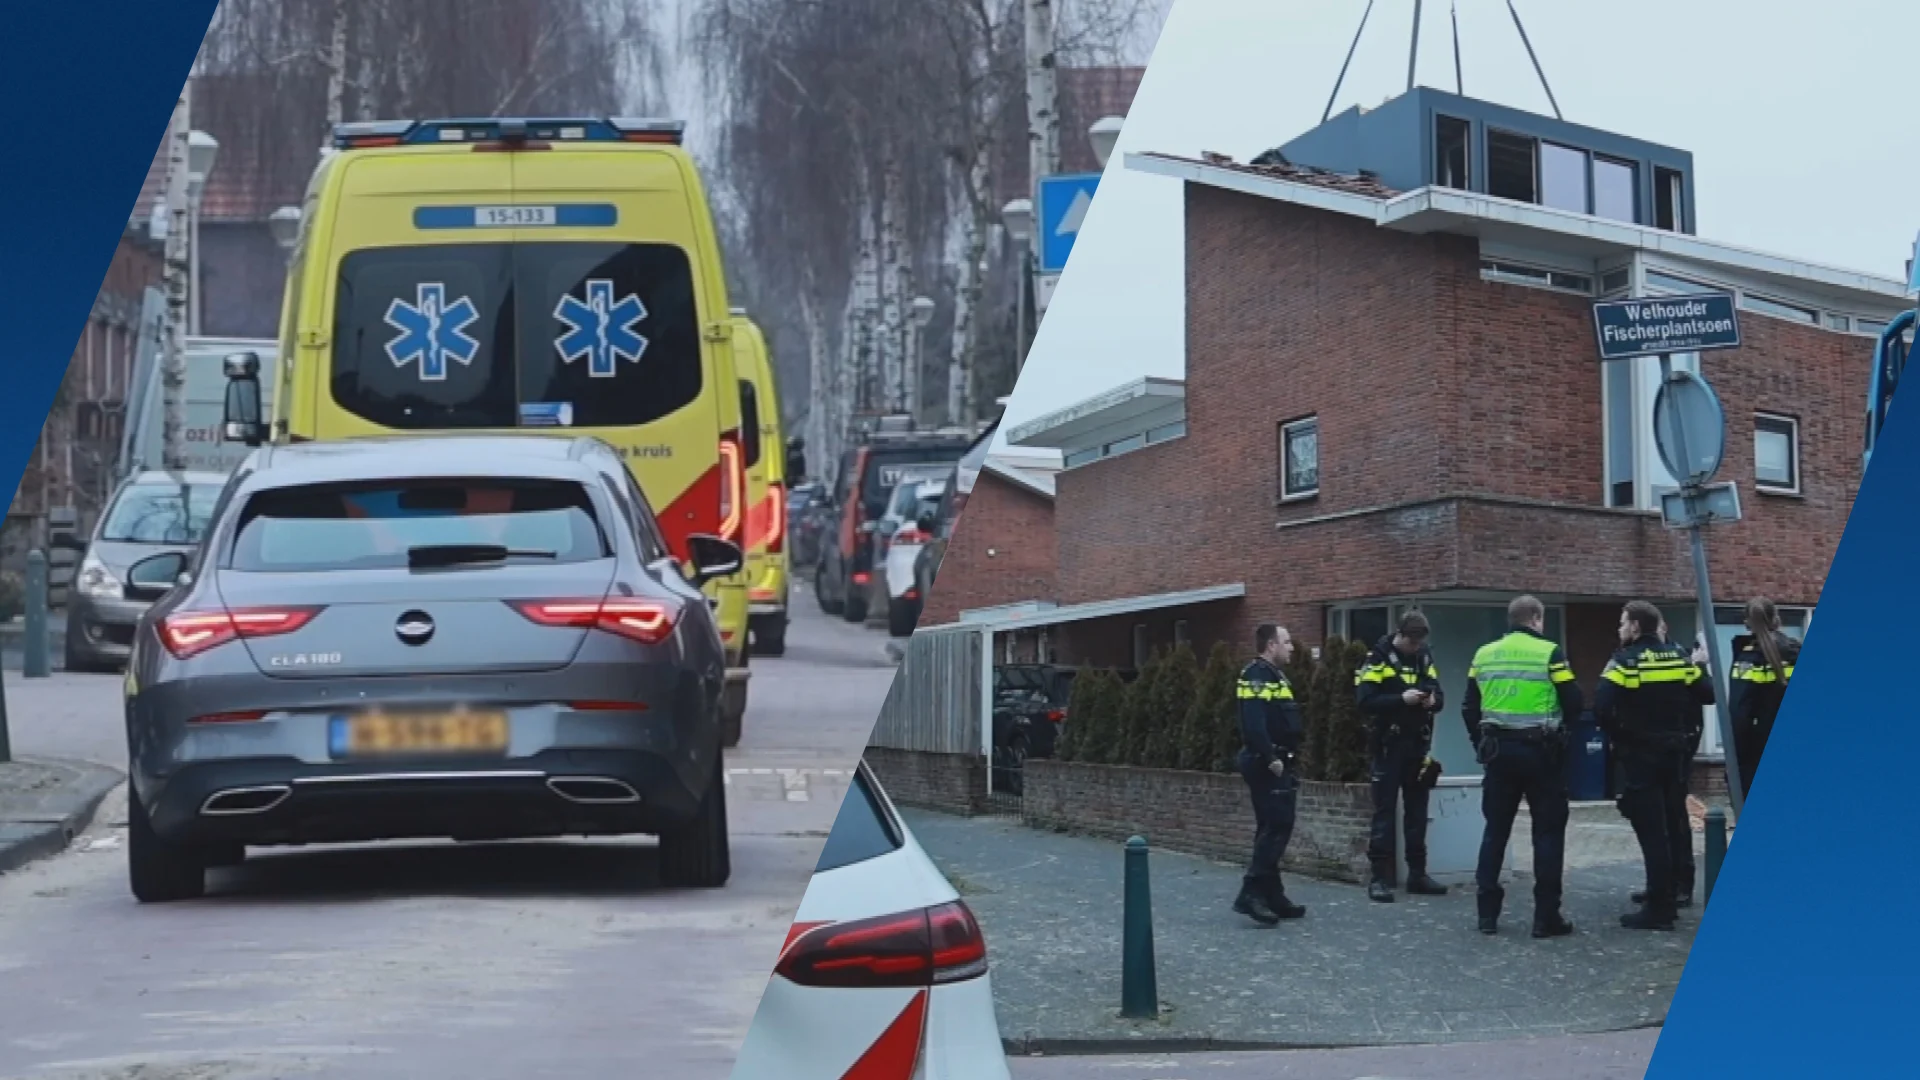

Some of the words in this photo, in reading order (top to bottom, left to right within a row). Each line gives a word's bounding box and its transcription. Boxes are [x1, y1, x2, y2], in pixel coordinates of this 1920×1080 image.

[488, 208, 545, 223] 15-133
[1603, 318, 1732, 342] Fischerplantsoen
[632, 443, 673, 457] kruis
